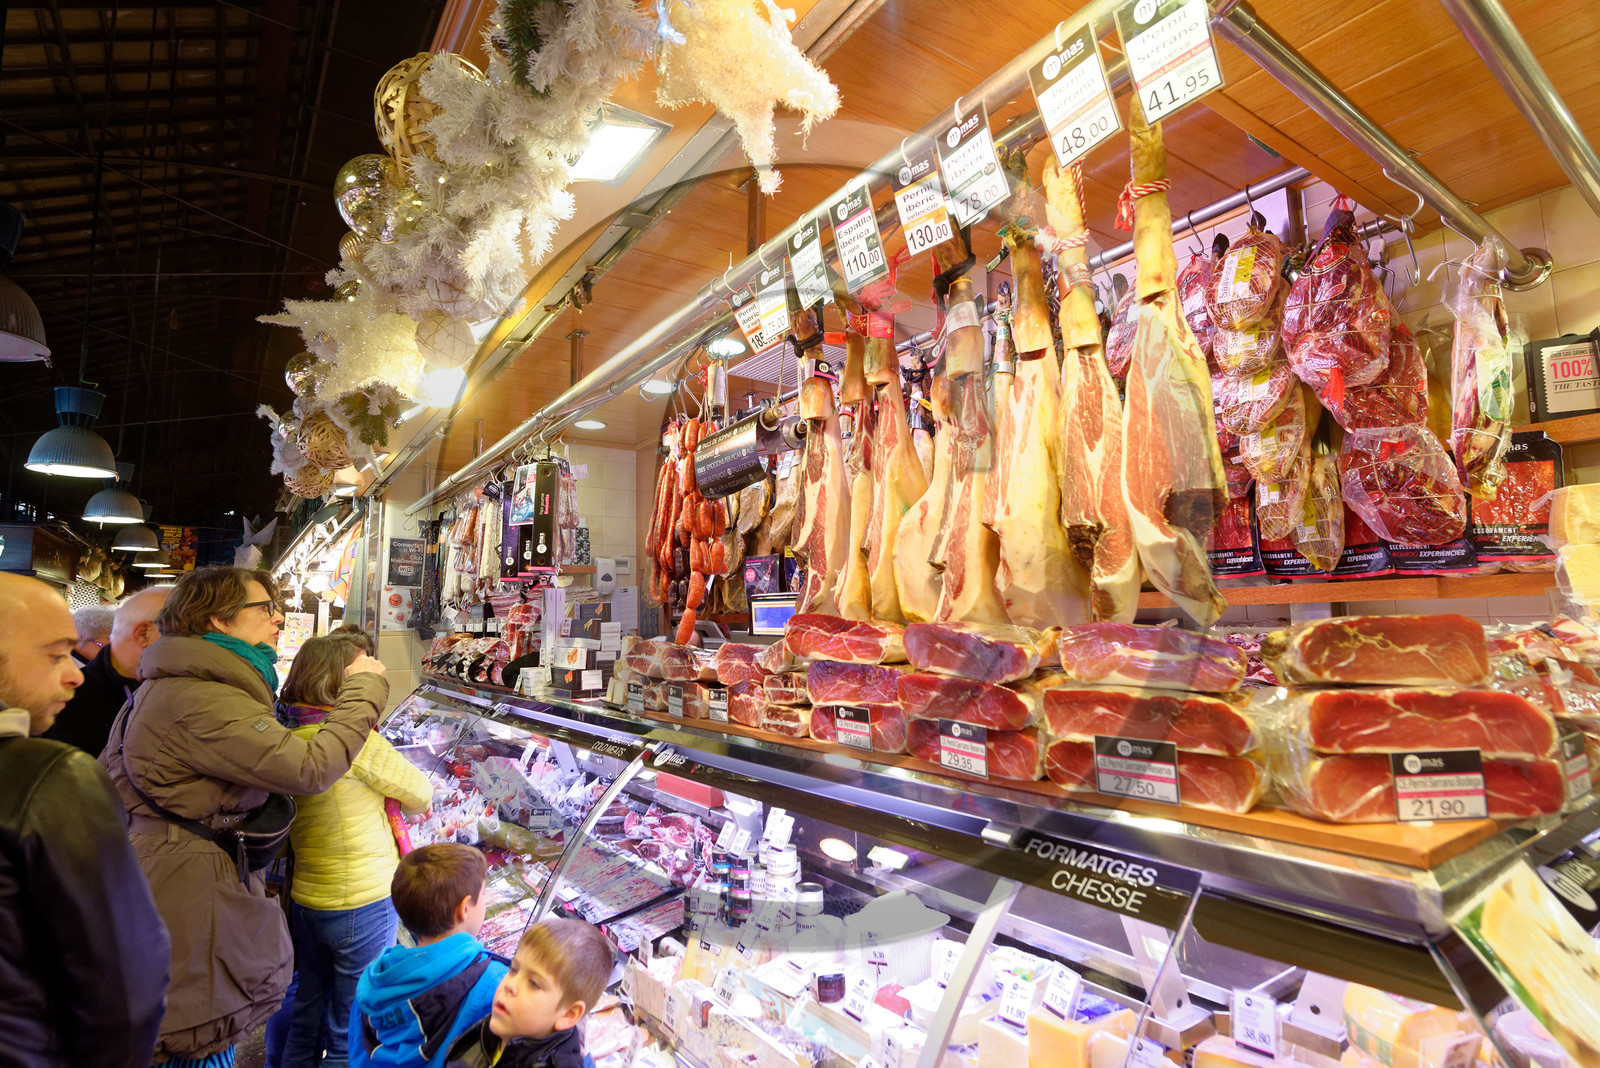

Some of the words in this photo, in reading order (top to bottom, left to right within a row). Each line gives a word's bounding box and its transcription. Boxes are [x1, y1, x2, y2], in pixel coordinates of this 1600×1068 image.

[1141, 10, 1187, 44] Pernil
[1060, 37, 1085, 64] mas
[1137, 21, 1199, 64] Serrano
[1049, 78, 1096, 115] Serrano
[1051, 68, 1086, 99] Pernil
[1148, 68, 1210, 112] 41,95
[960, 113, 979, 135] mas
[1061, 116, 1108, 155] 48,00
[947, 137, 983, 169] Pernil
[911, 160, 930, 176] mas
[848, 196, 862, 211] mas
[902, 182, 934, 204] Pernil
[837, 214, 872, 240] Espatlla
[1550, 359, 1593, 379] 100%
[1554, 382, 1572, 391] THE
[669, 753, 688, 765] mas
[1132, 745, 1153, 756] mas
[1023, 837, 1159, 888] FORMATGES
[1051, 870, 1148, 913] CHESSE
